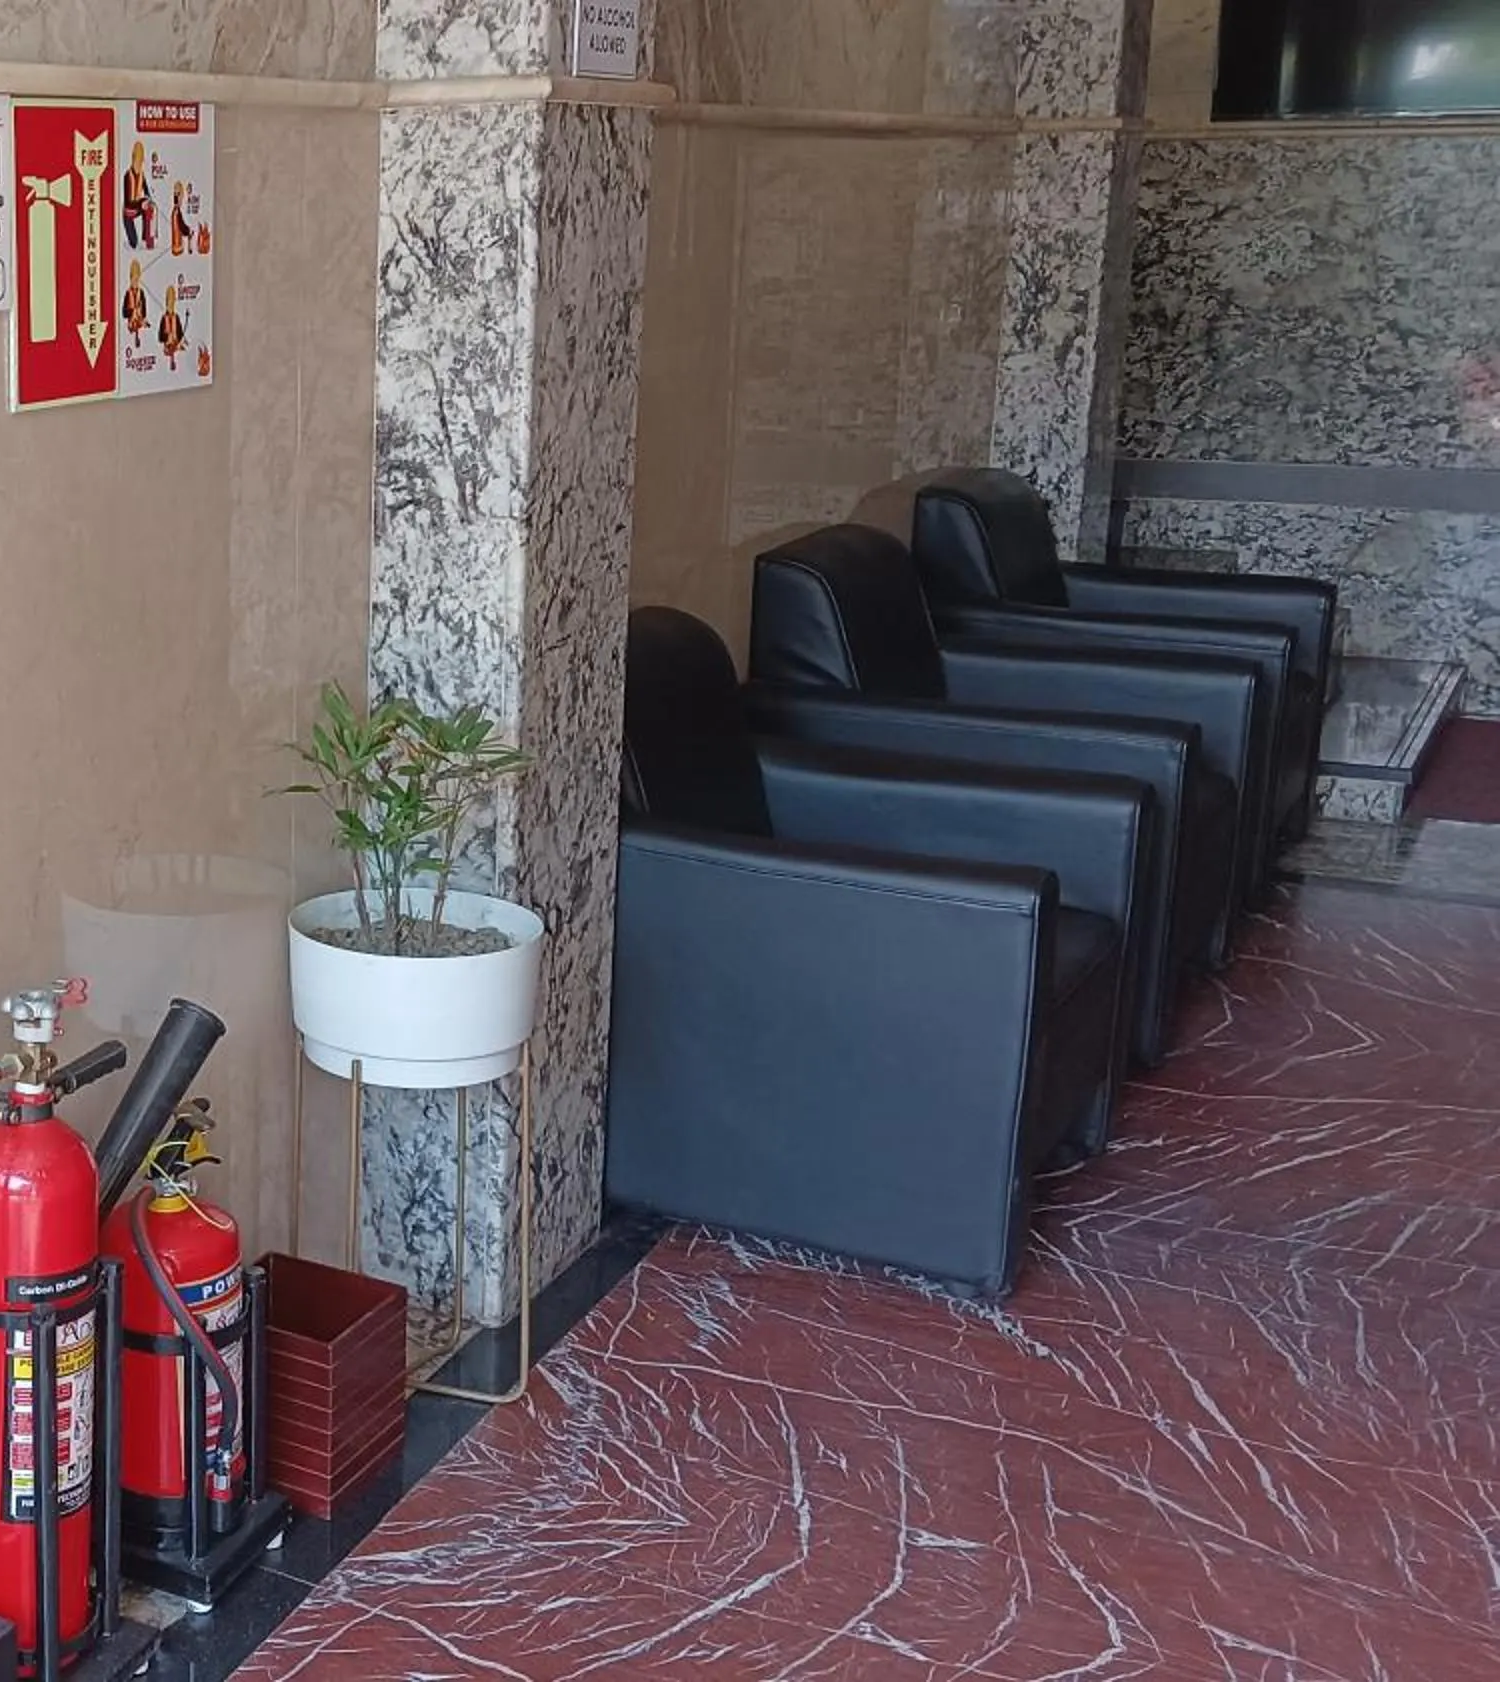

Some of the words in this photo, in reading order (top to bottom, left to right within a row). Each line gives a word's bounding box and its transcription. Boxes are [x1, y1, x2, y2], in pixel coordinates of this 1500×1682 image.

[583, 5, 597, 24] NO
[597, 7, 636, 29] ALCOHOL
[589, 33, 627, 54] ALLOWED
[140, 105, 164, 119] HOW
[165, 105, 179, 119] TO
[180, 106, 197, 120] USE
[81, 150, 103, 166] FIRE
[86, 179, 98, 349] EXTINGUISHER
[19, 1284, 55, 1295] Carbon
